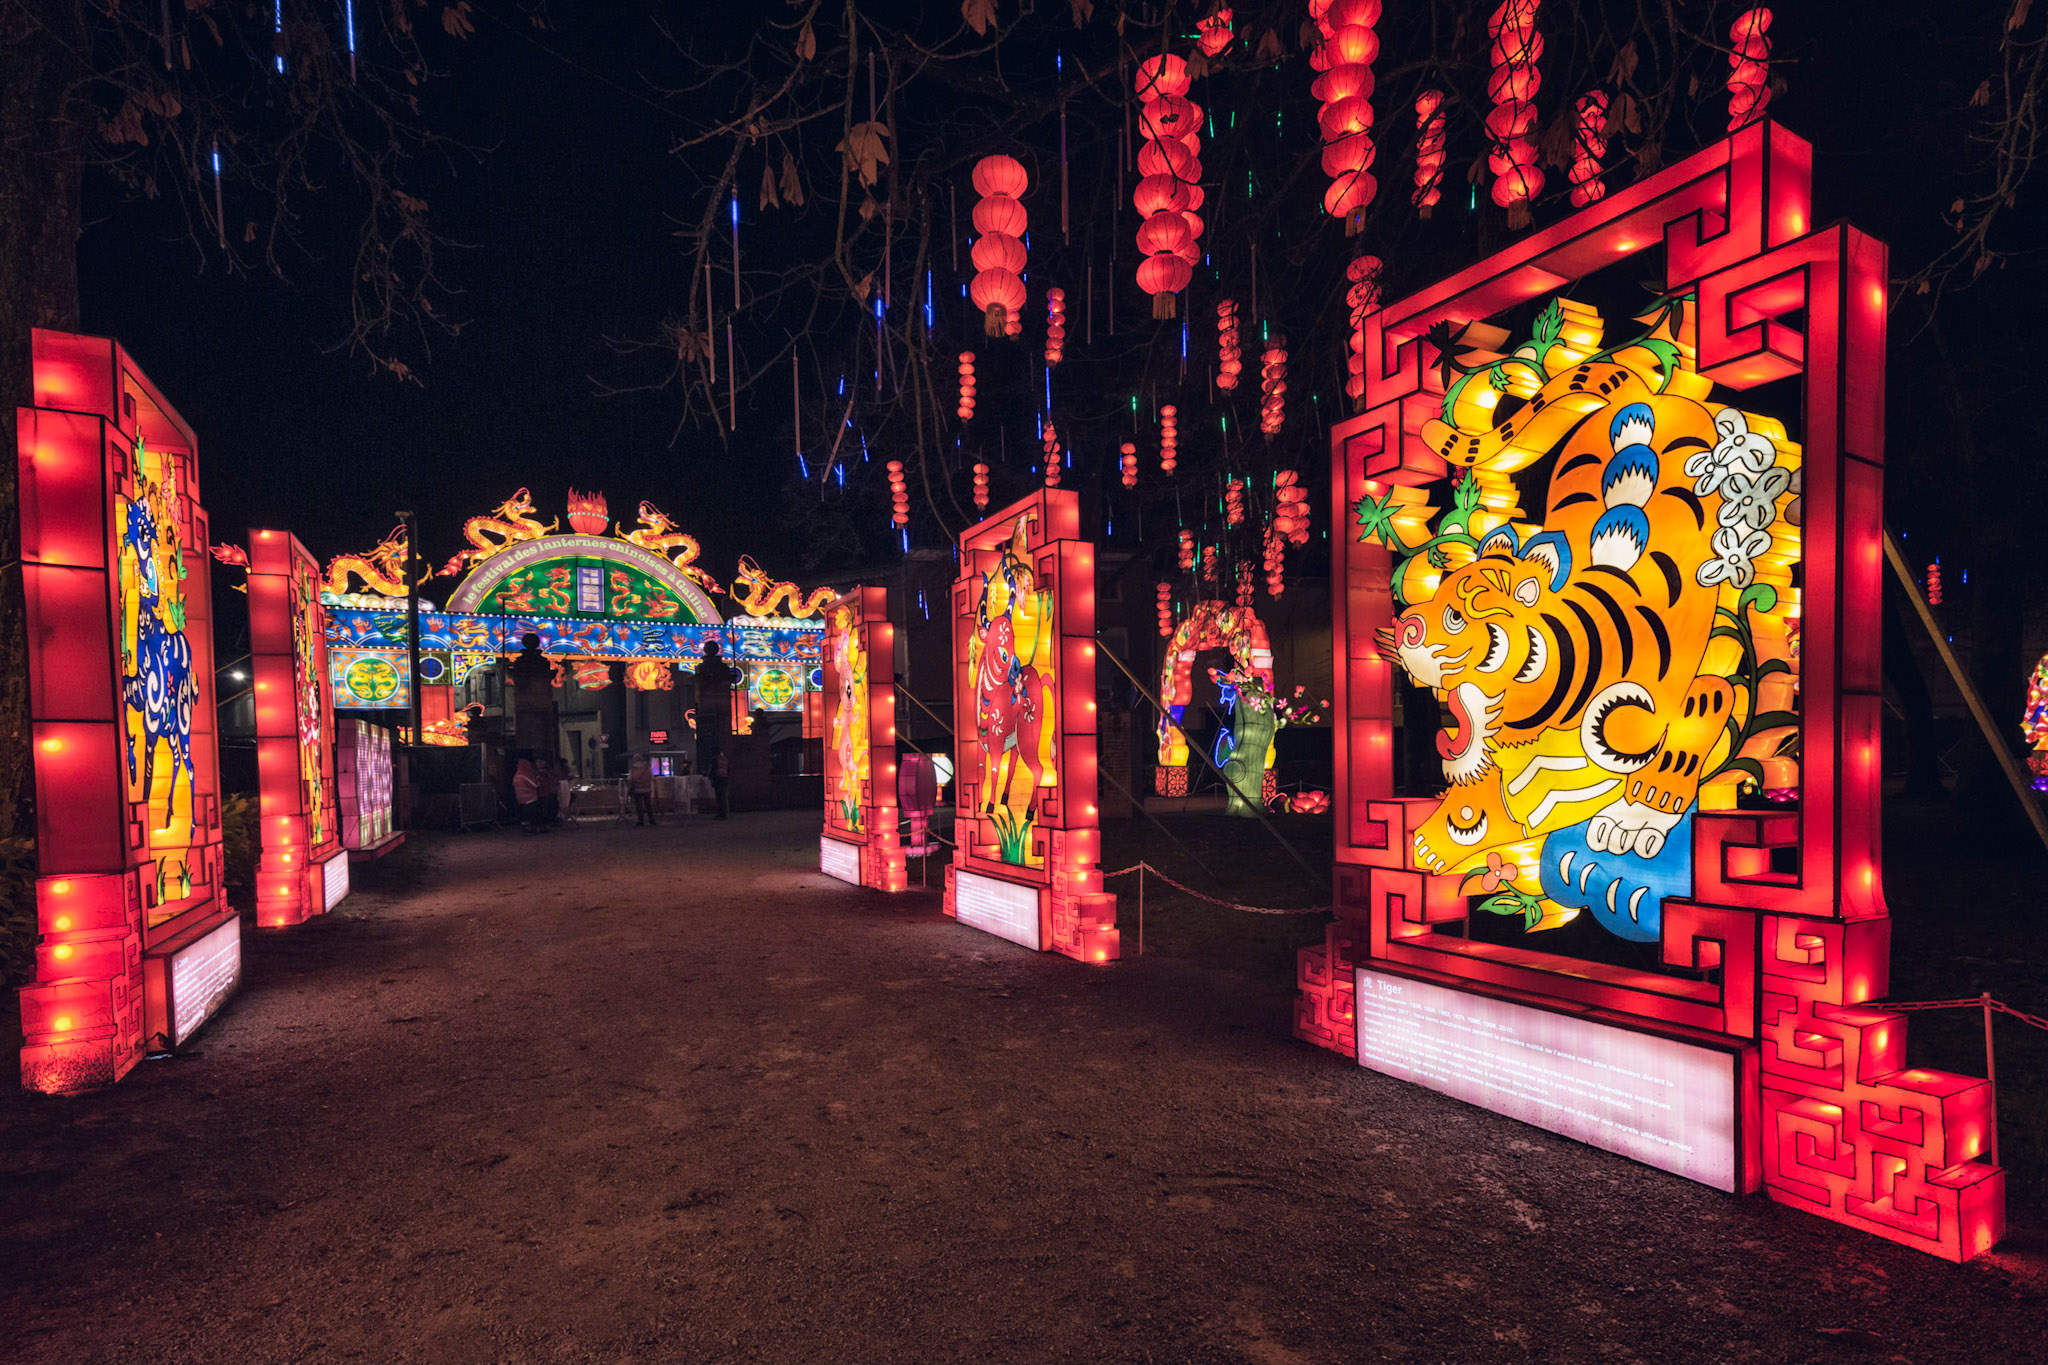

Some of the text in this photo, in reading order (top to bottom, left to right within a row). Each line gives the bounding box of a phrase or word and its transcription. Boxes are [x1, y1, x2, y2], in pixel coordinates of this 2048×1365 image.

[462, 592, 477, 605] le
[471, 555, 516, 593] festival
[514, 546, 538, 561] des
[537, 537, 607, 552] lanternes
[608, 542, 668, 576] chinoises
[675, 579, 708, 619] Gaillac
[1377, 980, 1402, 995] Tiger
